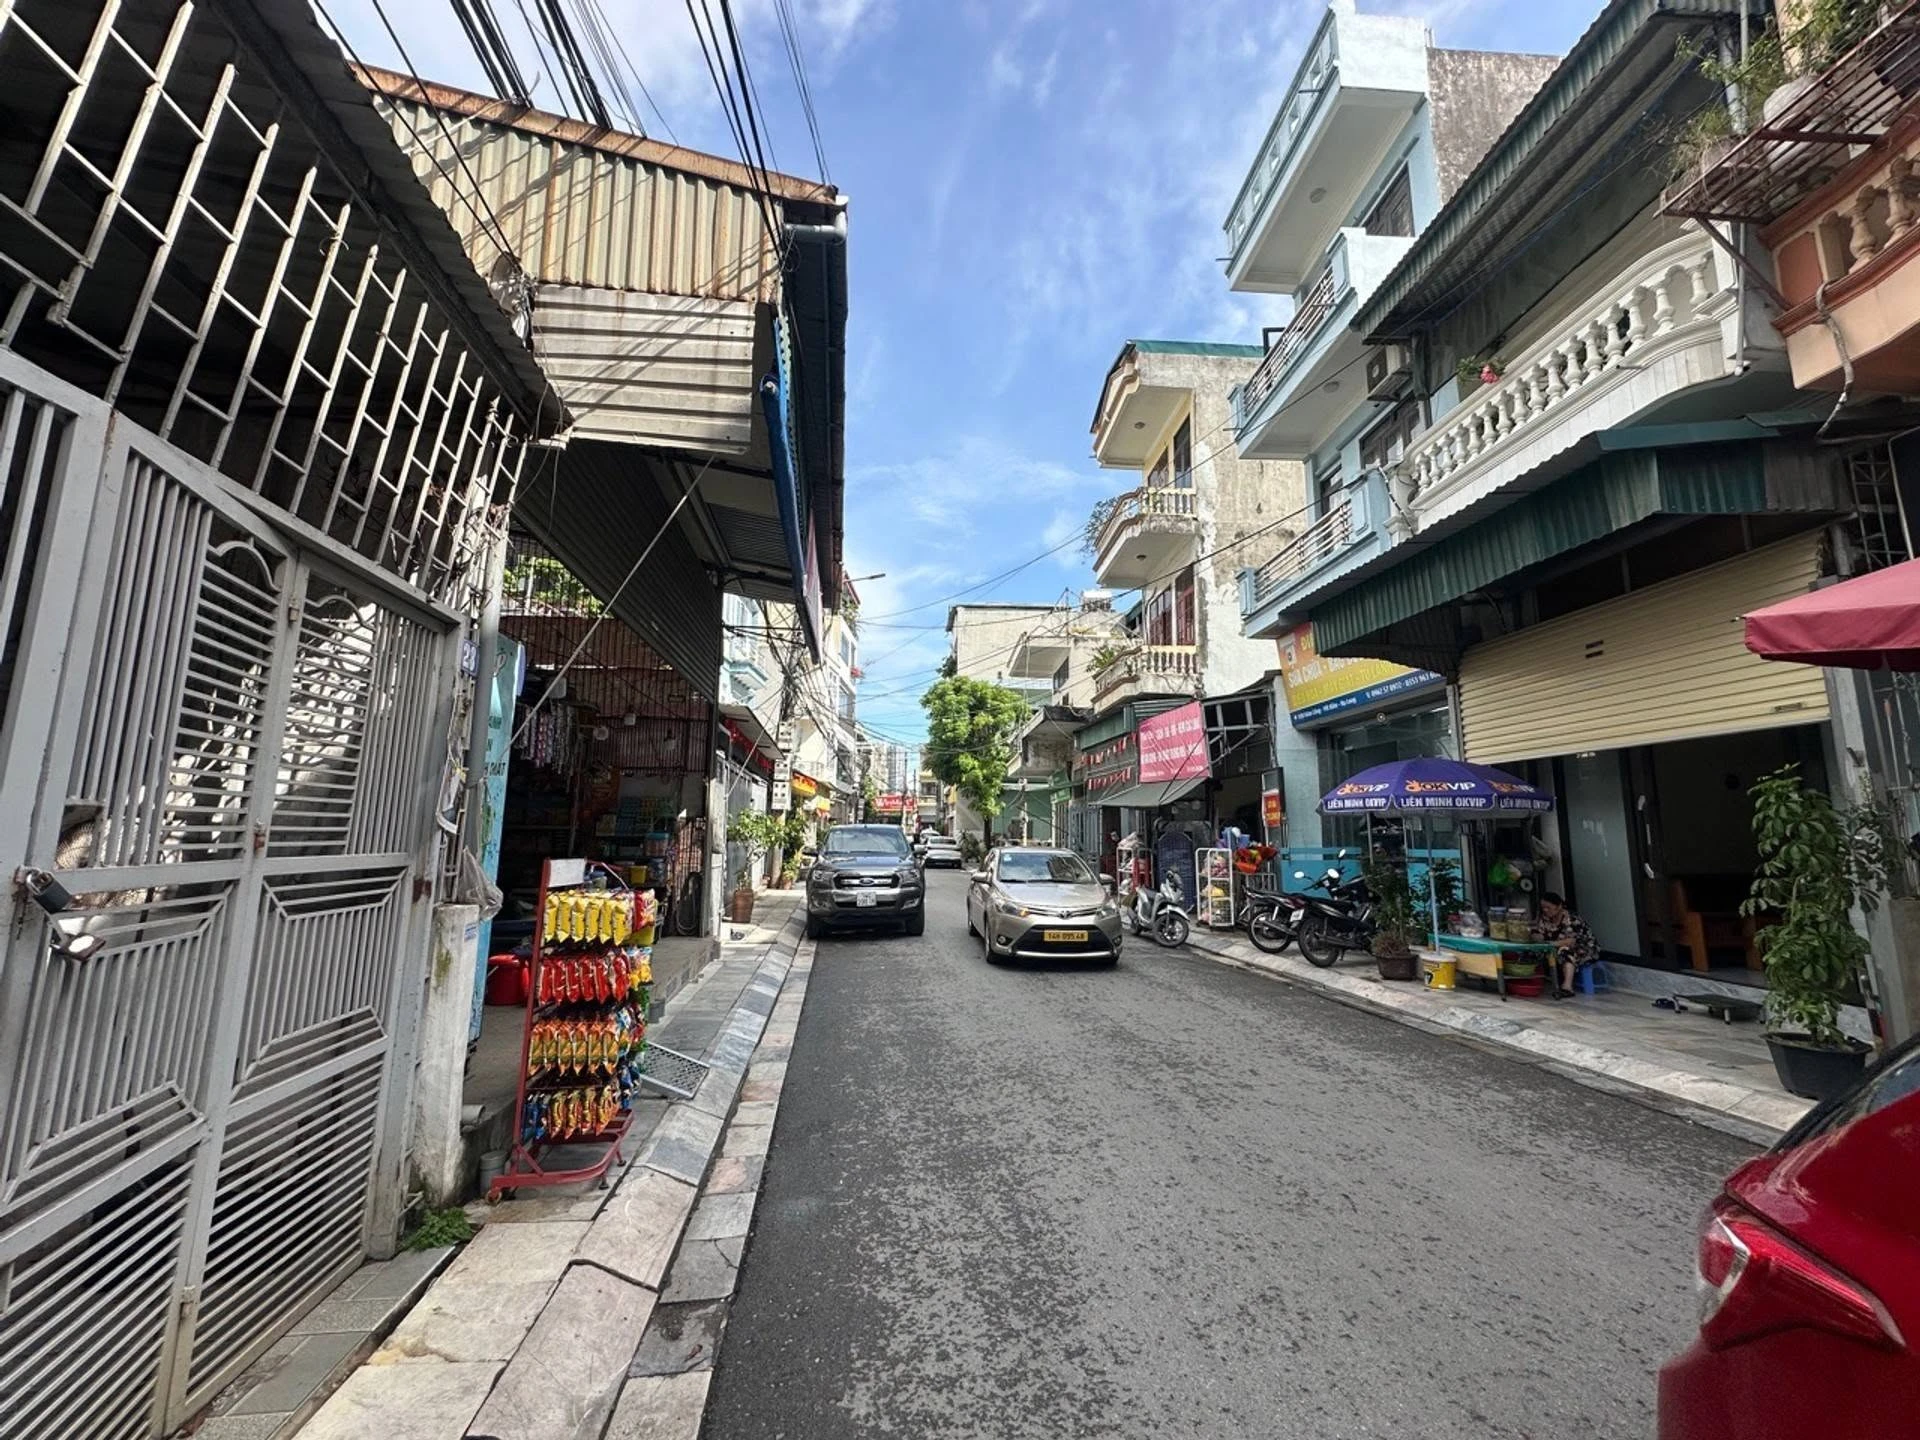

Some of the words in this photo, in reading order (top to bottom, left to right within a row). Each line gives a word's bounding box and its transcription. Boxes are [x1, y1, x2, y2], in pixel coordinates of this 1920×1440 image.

[1401, 795, 1423, 807] LIÊN
[1425, 797, 1453, 807] MINH
[1455, 797, 1486, 808] OKVIP
